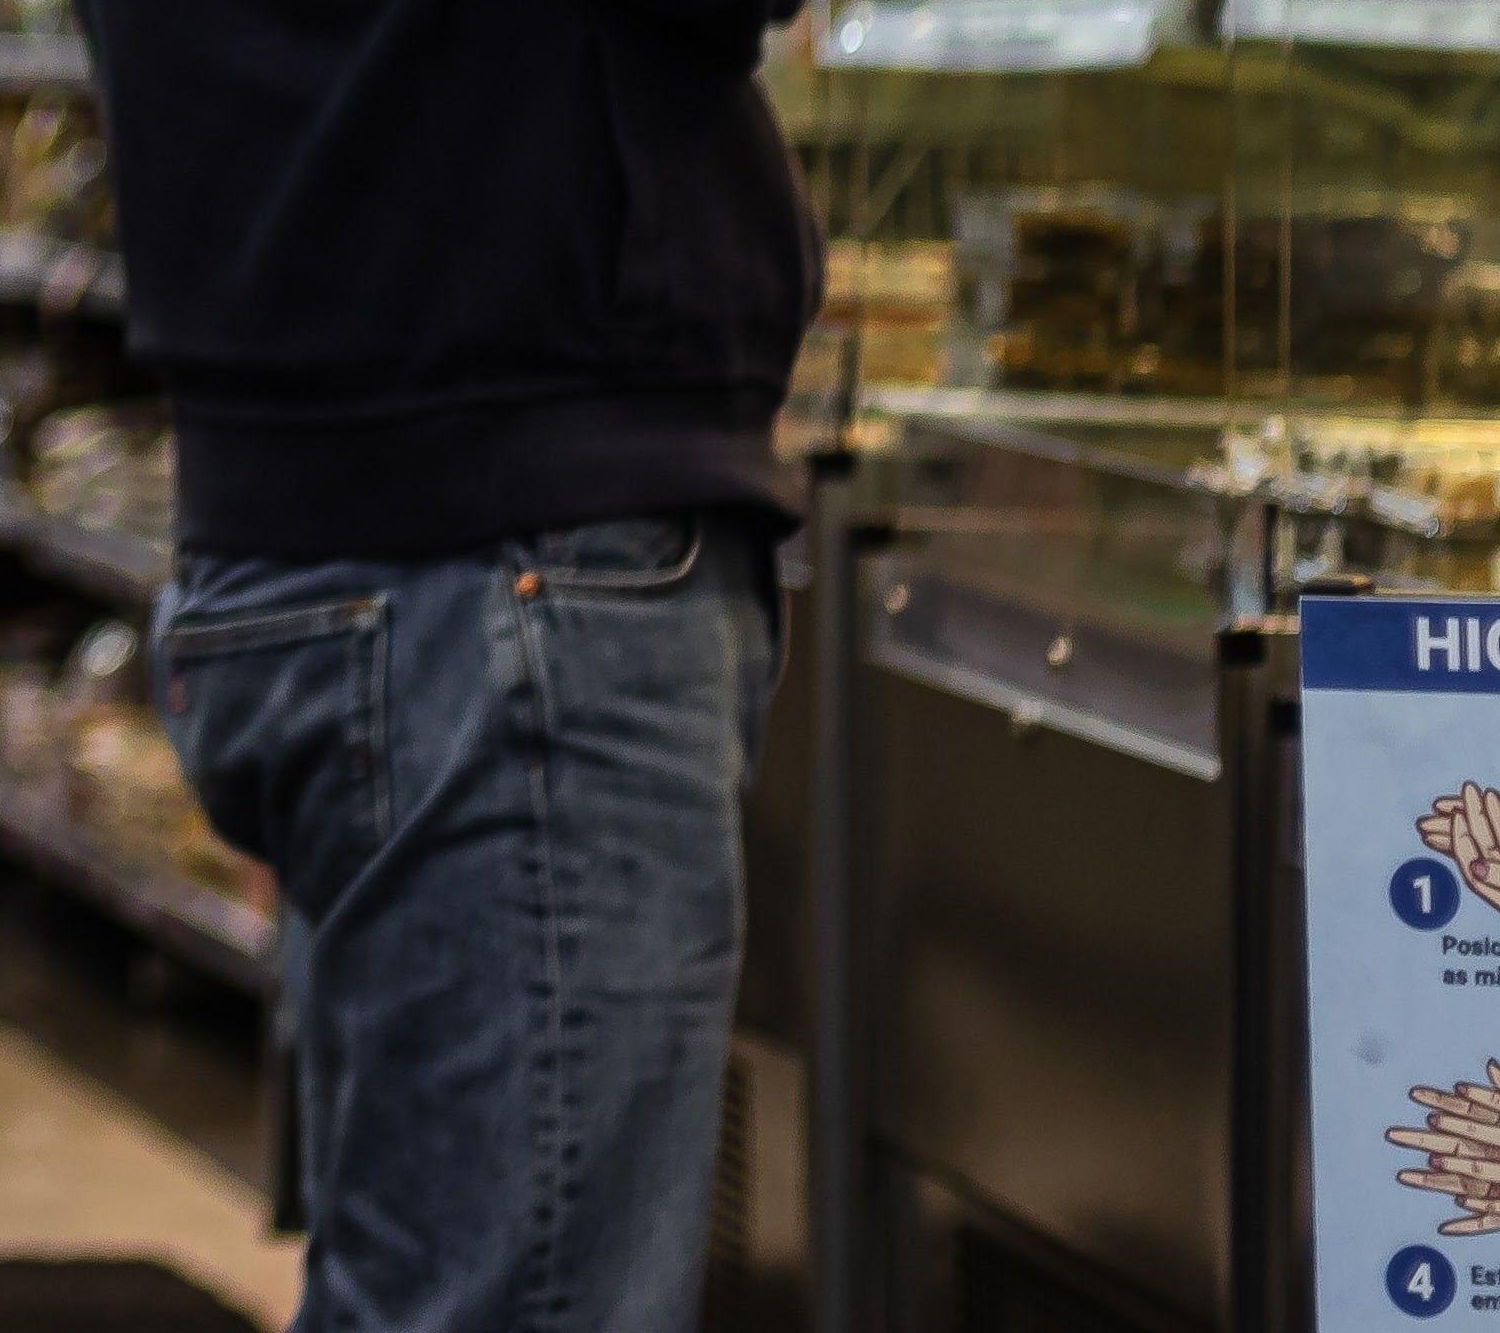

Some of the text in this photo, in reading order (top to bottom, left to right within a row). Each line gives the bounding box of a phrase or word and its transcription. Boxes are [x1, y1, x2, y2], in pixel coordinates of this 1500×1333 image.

[1412, 875, 1432, 914] 1
[1442, 972, 1467, 987] as
[1405, 1263, 1434, 1302] 4
